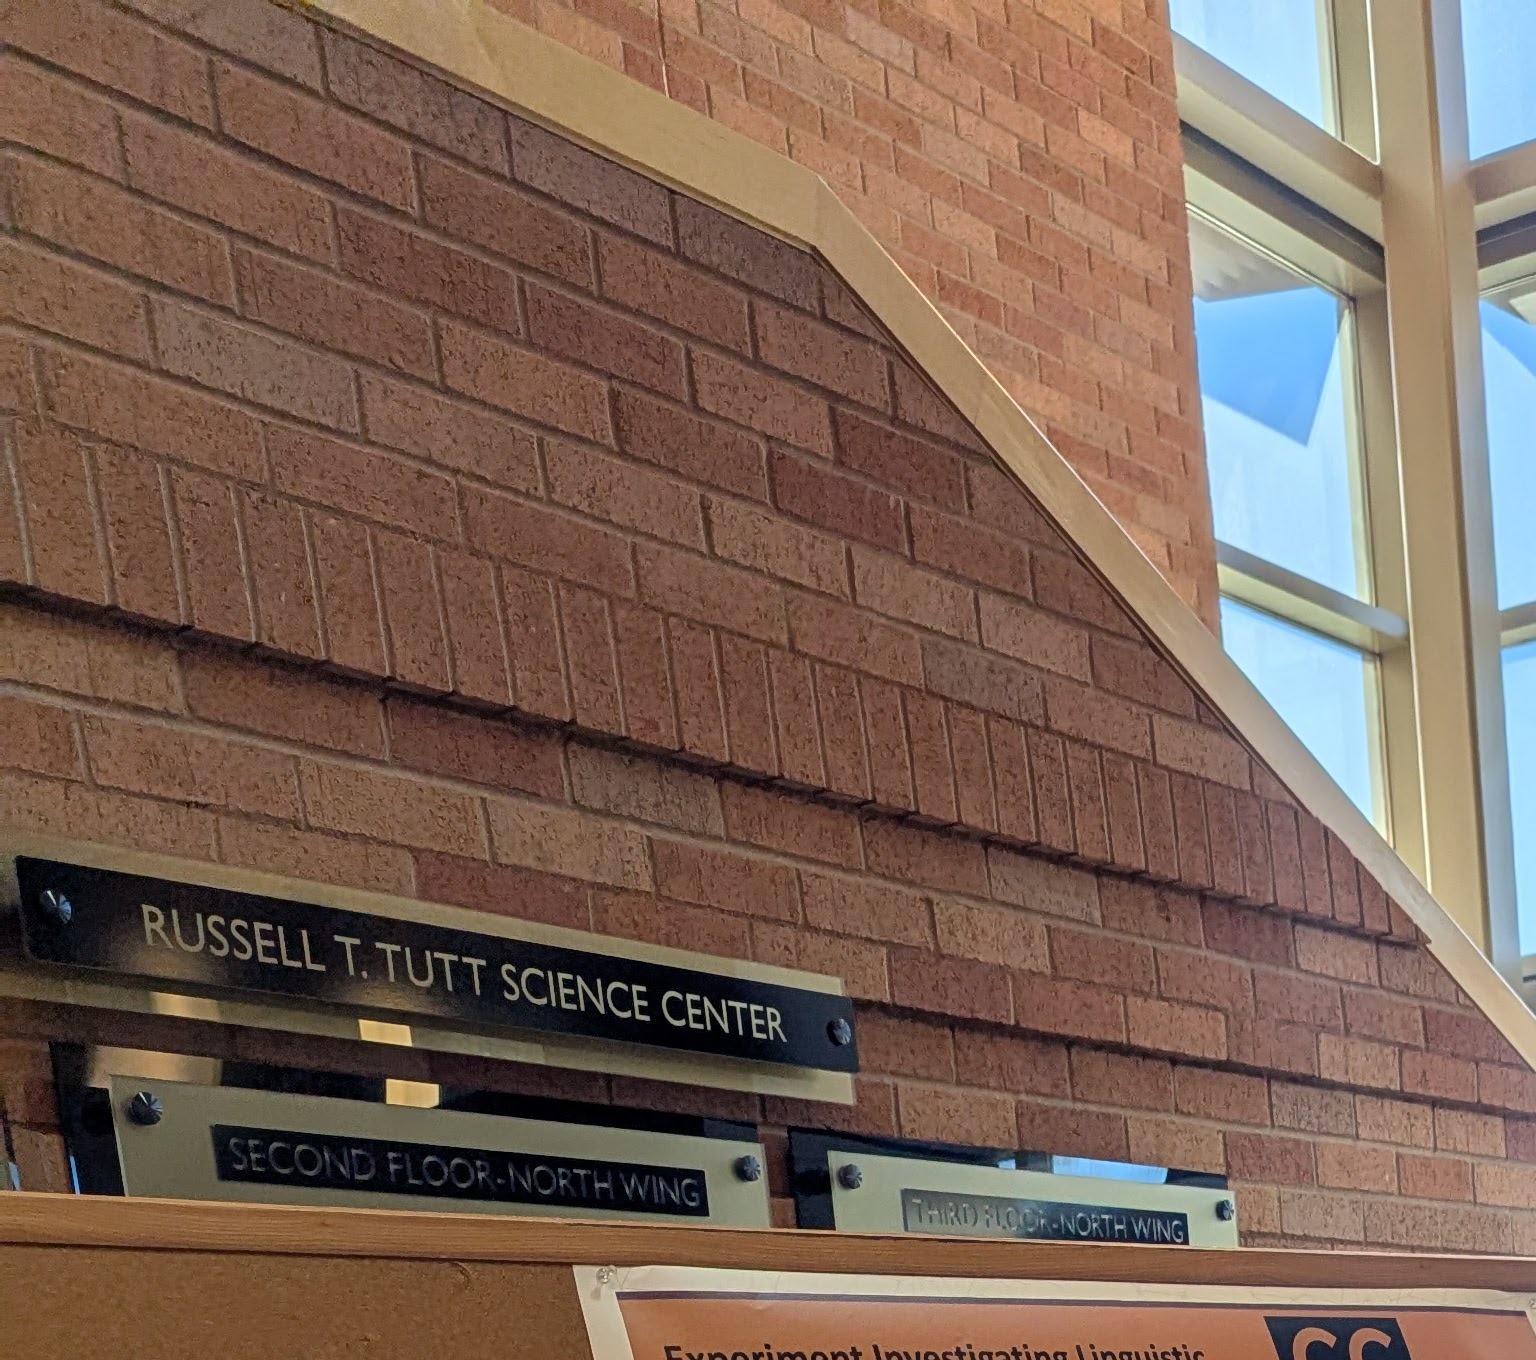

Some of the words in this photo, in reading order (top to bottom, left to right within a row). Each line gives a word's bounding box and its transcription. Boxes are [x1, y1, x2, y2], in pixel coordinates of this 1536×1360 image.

[141, 904, 326, 972] RUSSELL
[333, 934, 369, 980] T.
[375, 941, 487, 997] TUTT
[501, 963, 651, 1022] SCIENCE
[661, 990, 788, 1043] CENTER
[228, 1137, 376, 1182] SECOND
[388, 1151, 615, 1200] FLOOR-NORTH
[622, 1172, 701, 1208] WING
[911, 1199, 980, 1229] THIRD
[984, 1203, 1127, 1241] FLOOR-NORTH
[1131, 1216, 1186, 1244] WING
